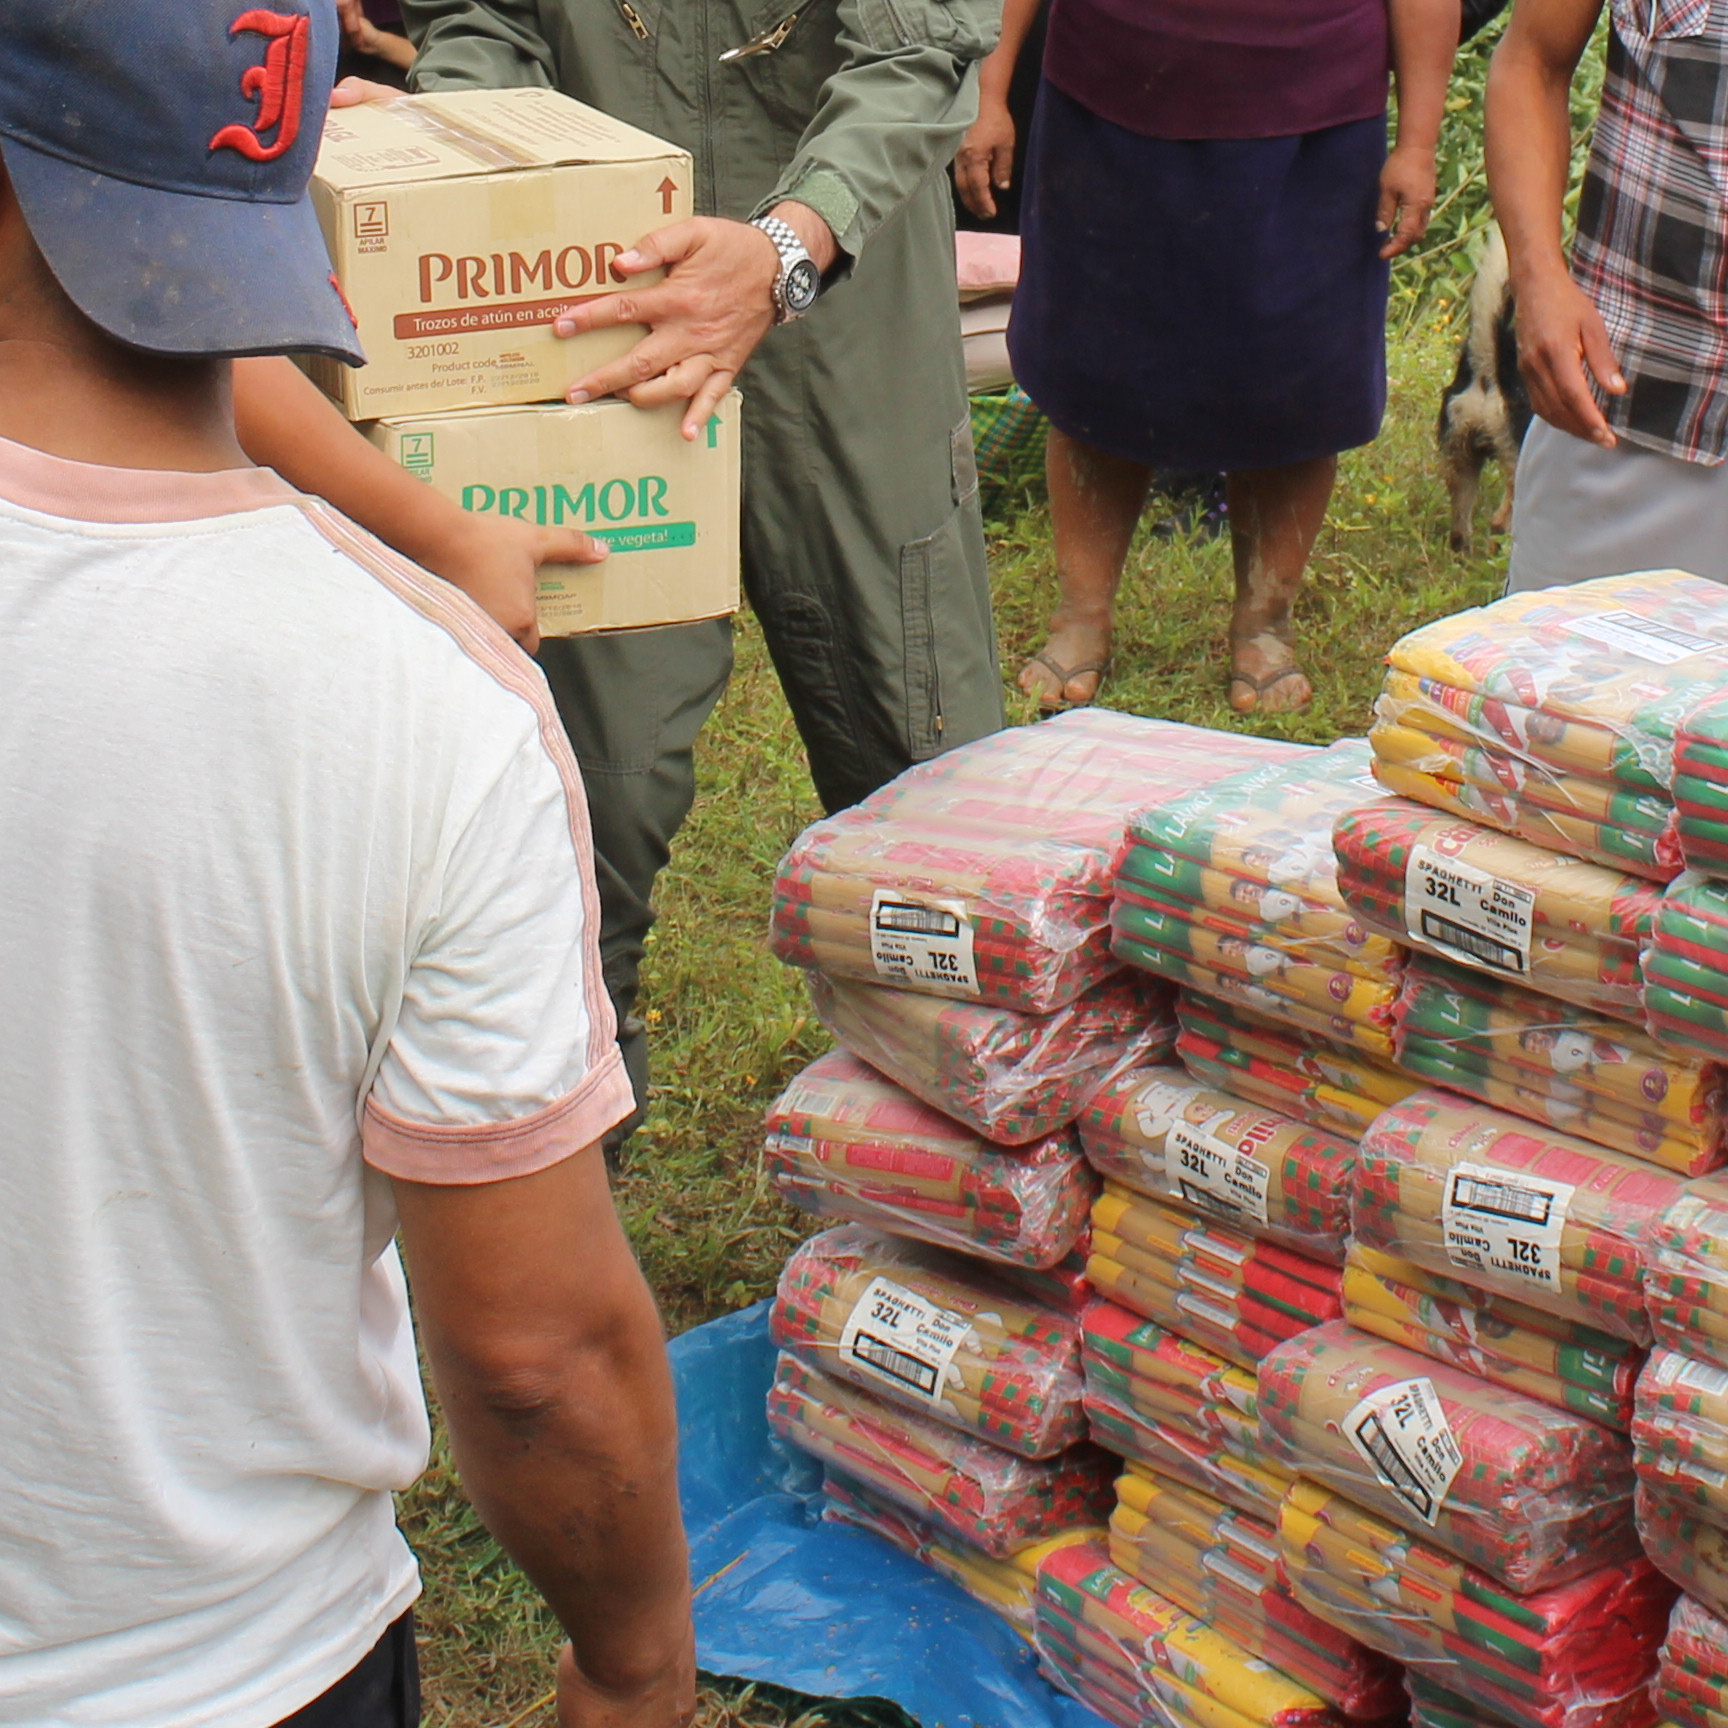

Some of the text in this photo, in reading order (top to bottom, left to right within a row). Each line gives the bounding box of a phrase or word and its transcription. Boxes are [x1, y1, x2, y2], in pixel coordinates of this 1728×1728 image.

[365, 207, 377, 222] 7
[418, 242, 628, 303] PRIMOR
[414, 304, 571, 332] Trozos de atún en aceit
[407, 342, 460, 359] 3201002
[432, 359, 470, 373] Product
[472, 357, 497, 369] code
[363, 382, 405, 396] Consumir
[406, 382, 428, 392] antes
[447, 376, 467, 387] Lote:
[411, 438, 422, 453] 7
[461, 475, 670, 526] PRIMOR
[1417, 859, 1482, 894] SPAGHETTI
[1425, 877, 1461, 907] 32L
[1492, 892, 1516, 909] Don
[1480, 899, 1527, 926] Camilo
[876, 952, 913, 965] Camilo
[888, 966, 906, 975] Don
[928, 951, 958, 971] 32L
[915, 969, 969, 984] SPAGHETTI
[1175, 1133, 1227, 1167] SPAGHETTI
[1180, 1149, 1209, 1178] 32L
[1235, 1167, 1253, 1183] Don
[1224, 1172, 1262, 1200] Camilo
[1449, 1232, 1491, 1252] Camilo
[1507, 1238, 1542, 1264] 32L
[1461, 1249, 1481, 1262] Don
[1491, 1256, 1551, 1280] SPAGHETTI
[871, 1302, 900, 1329] 32L
[874, 1287, 926, 1320] SPAGHETTI
[916, 1323, 954, 1348] Camilo
[932, 1318, 952, 1332] Don
[1390, 1393, 1415, 1430] 32L
[1416, 1435, 1446, 1483] Camilo
[1431, 1436, 1446, 1460] Don
